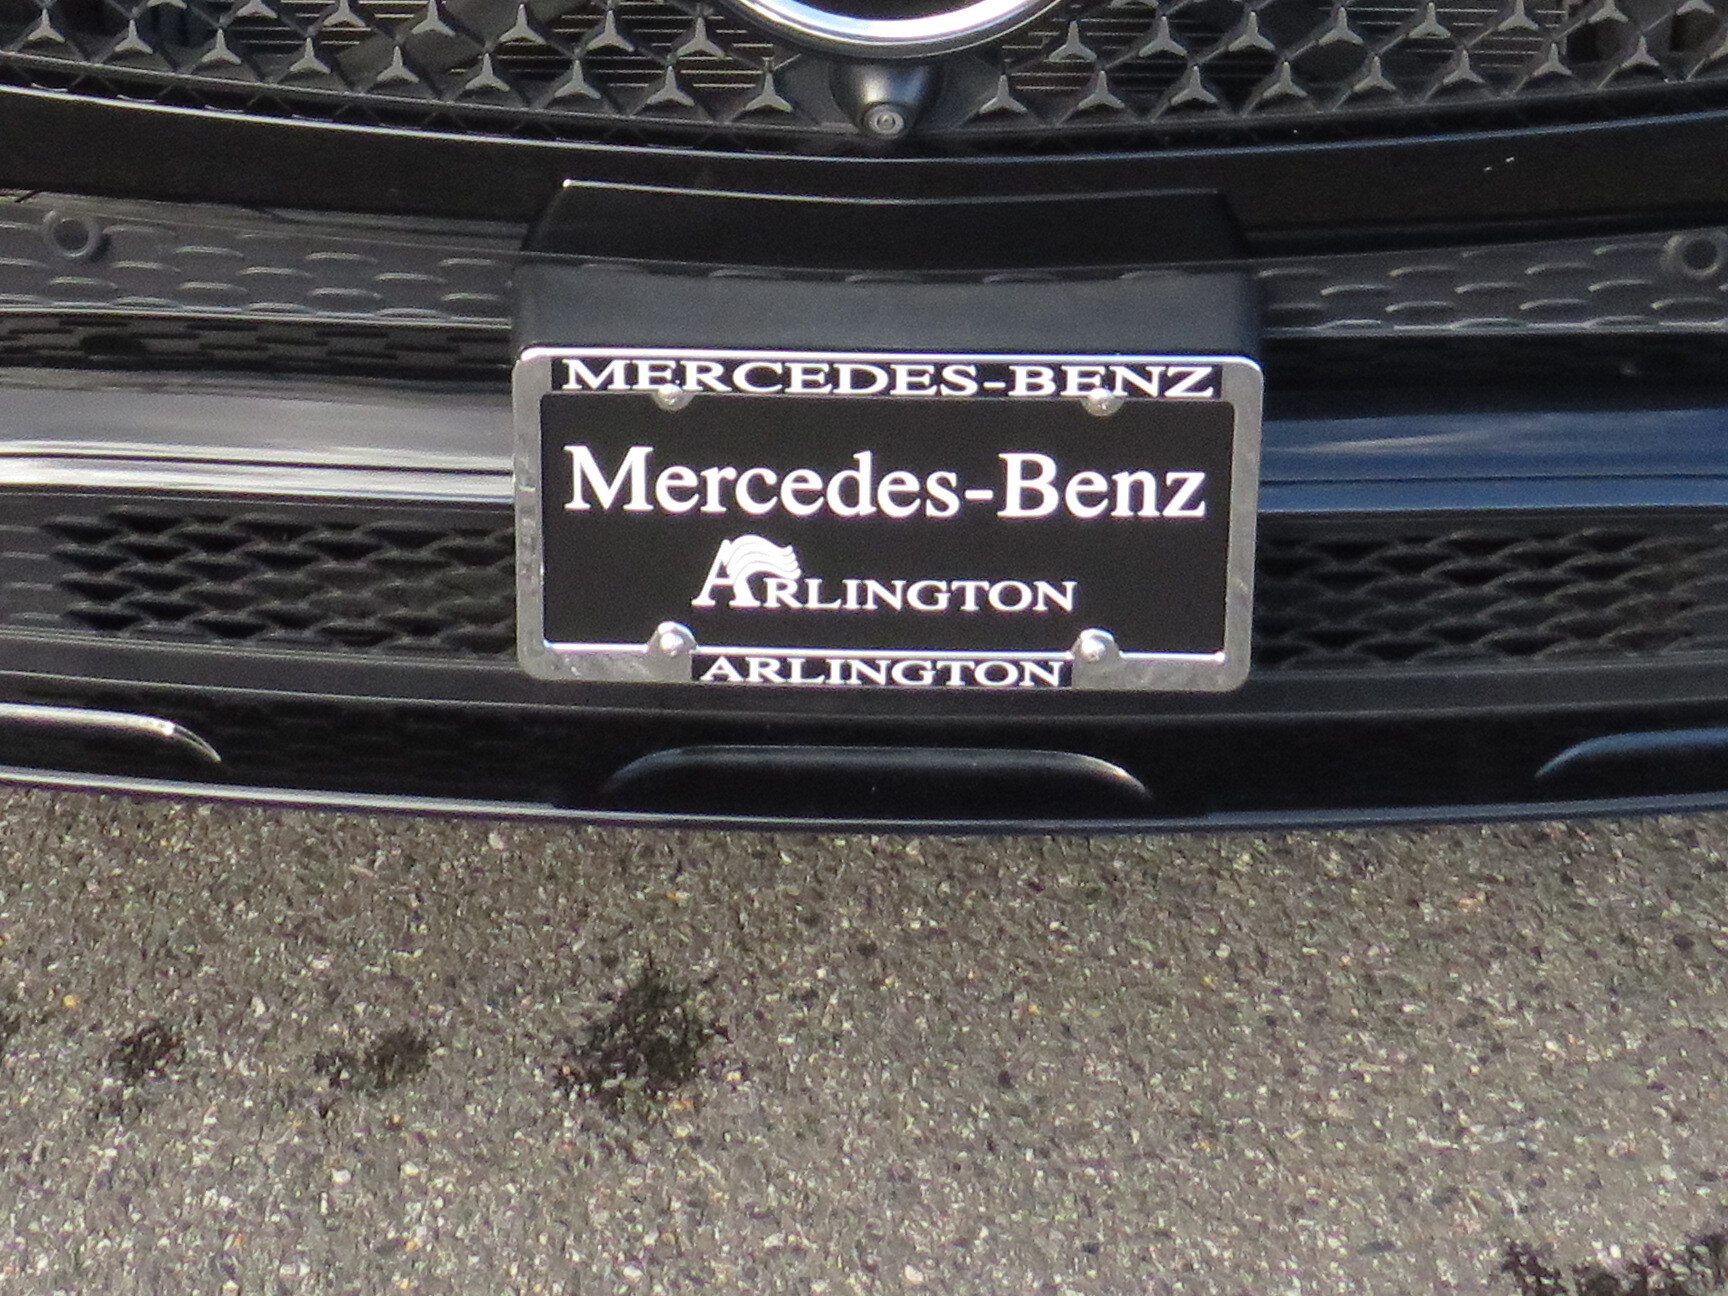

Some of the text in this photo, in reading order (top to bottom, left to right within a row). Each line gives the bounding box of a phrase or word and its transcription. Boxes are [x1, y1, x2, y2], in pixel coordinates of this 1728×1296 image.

[561, 358, 1216, 400] MERCEDES-BENZ
[562, 443, 1206, 520] Mercedes-Benz
[691, 533, 1078, 612] ARLINGTON
[698, 655, 1064, 688] ARLINGTON
